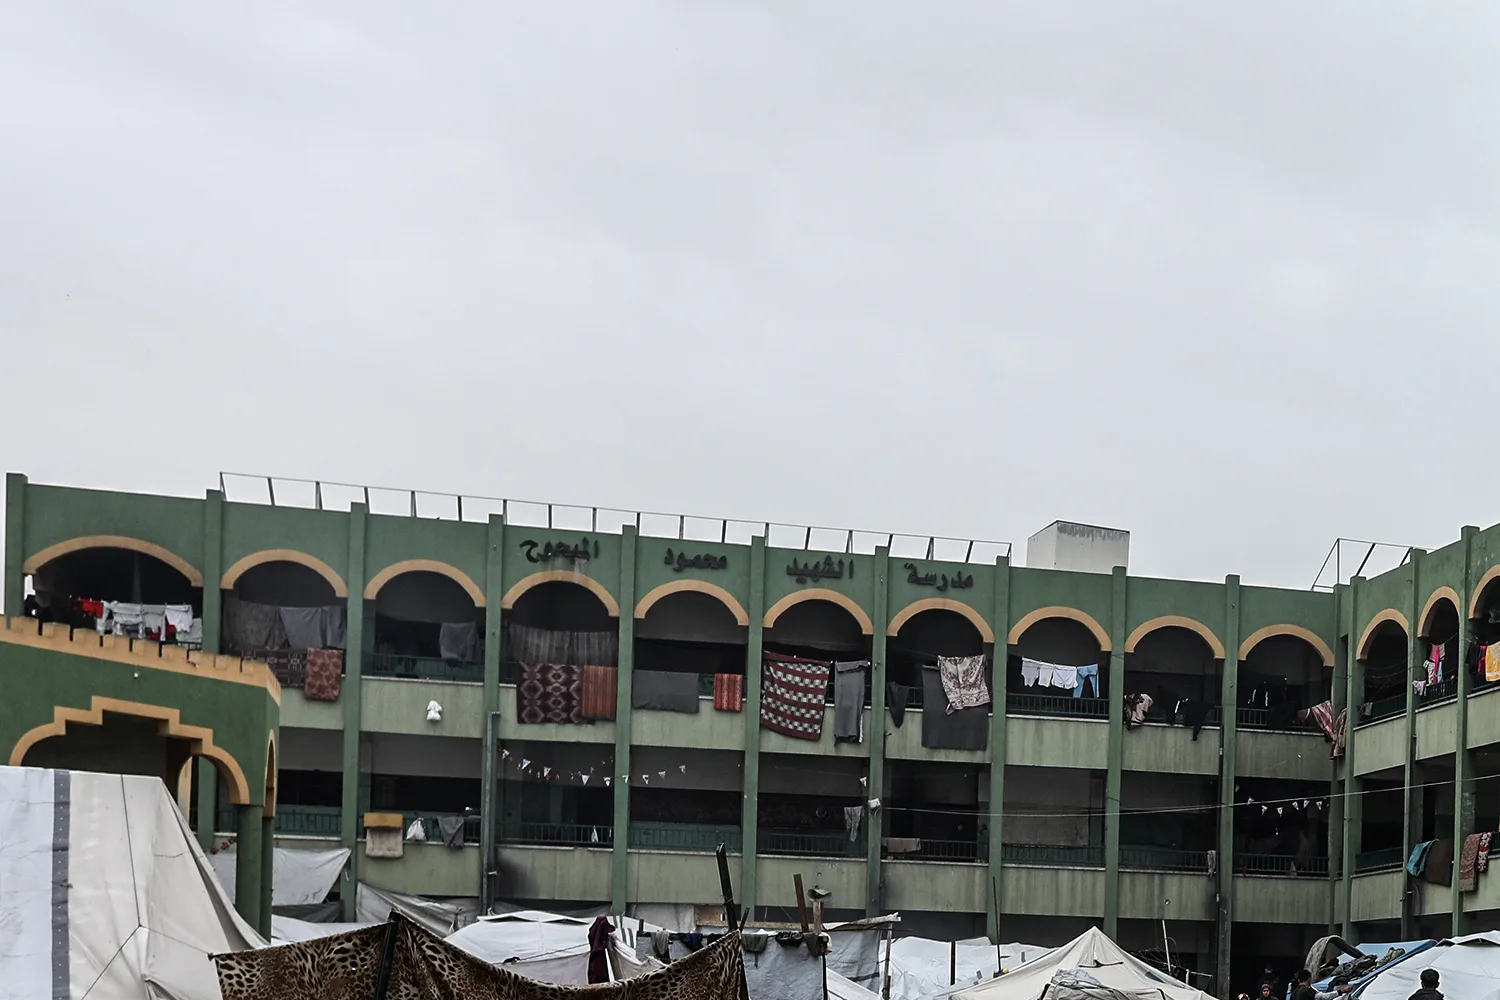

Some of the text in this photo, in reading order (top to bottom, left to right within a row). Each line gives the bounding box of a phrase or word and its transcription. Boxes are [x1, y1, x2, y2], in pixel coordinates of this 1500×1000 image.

[663, 547, 728, 573] محمود
[786, 554, 855, 585] الشهيد
[903, 562, 974, 592] مدرسة
